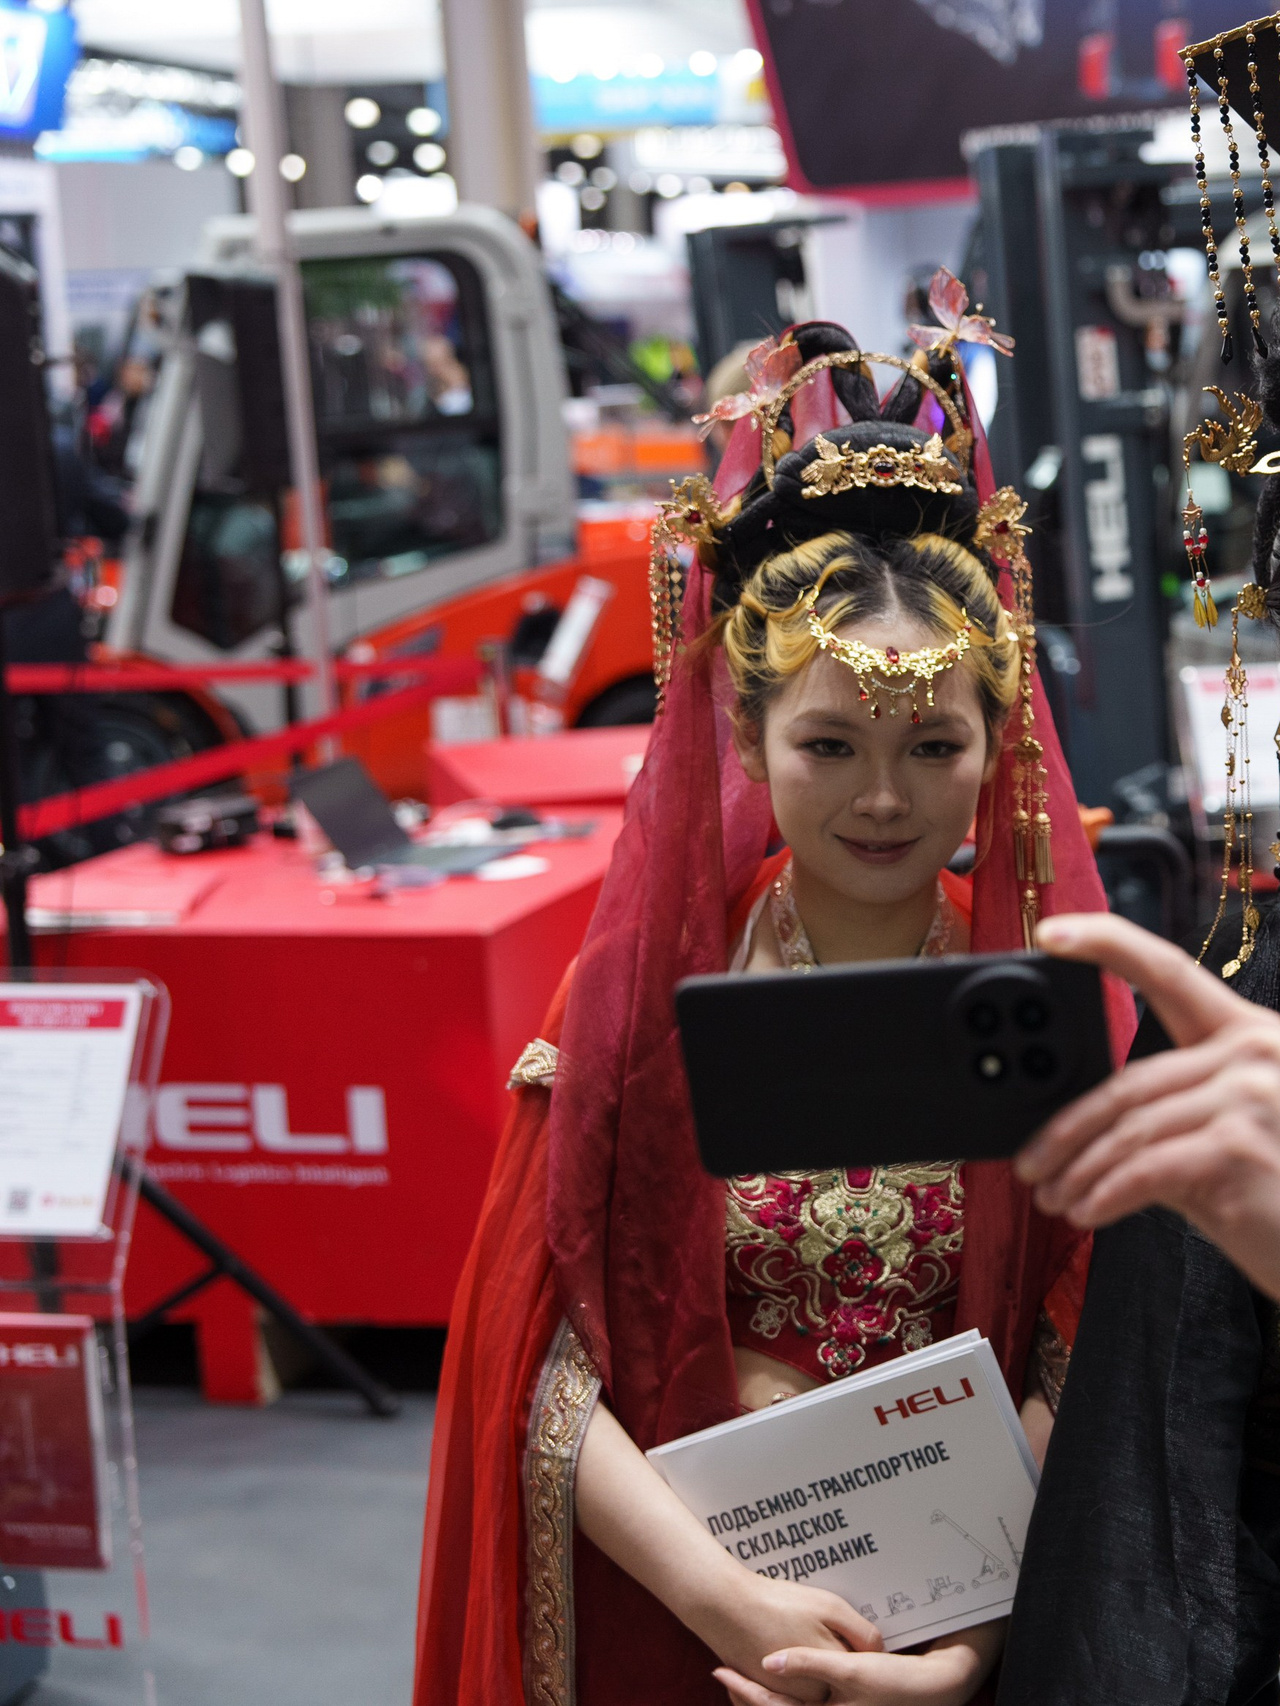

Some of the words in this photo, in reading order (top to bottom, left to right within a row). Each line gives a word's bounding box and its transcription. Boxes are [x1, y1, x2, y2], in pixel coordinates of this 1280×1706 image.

[1081, 434, 1135, 601] HELI
[873, 1377, 976, 1426] HELI
[707, 1440, 950, 1537] ПОДЪЕМНО-ТРАНСПОРТНОЕ
[737, 1508, 849, 1561] СКЛАДСКОЕ
[0, 1608, 124, 1651] ELI
